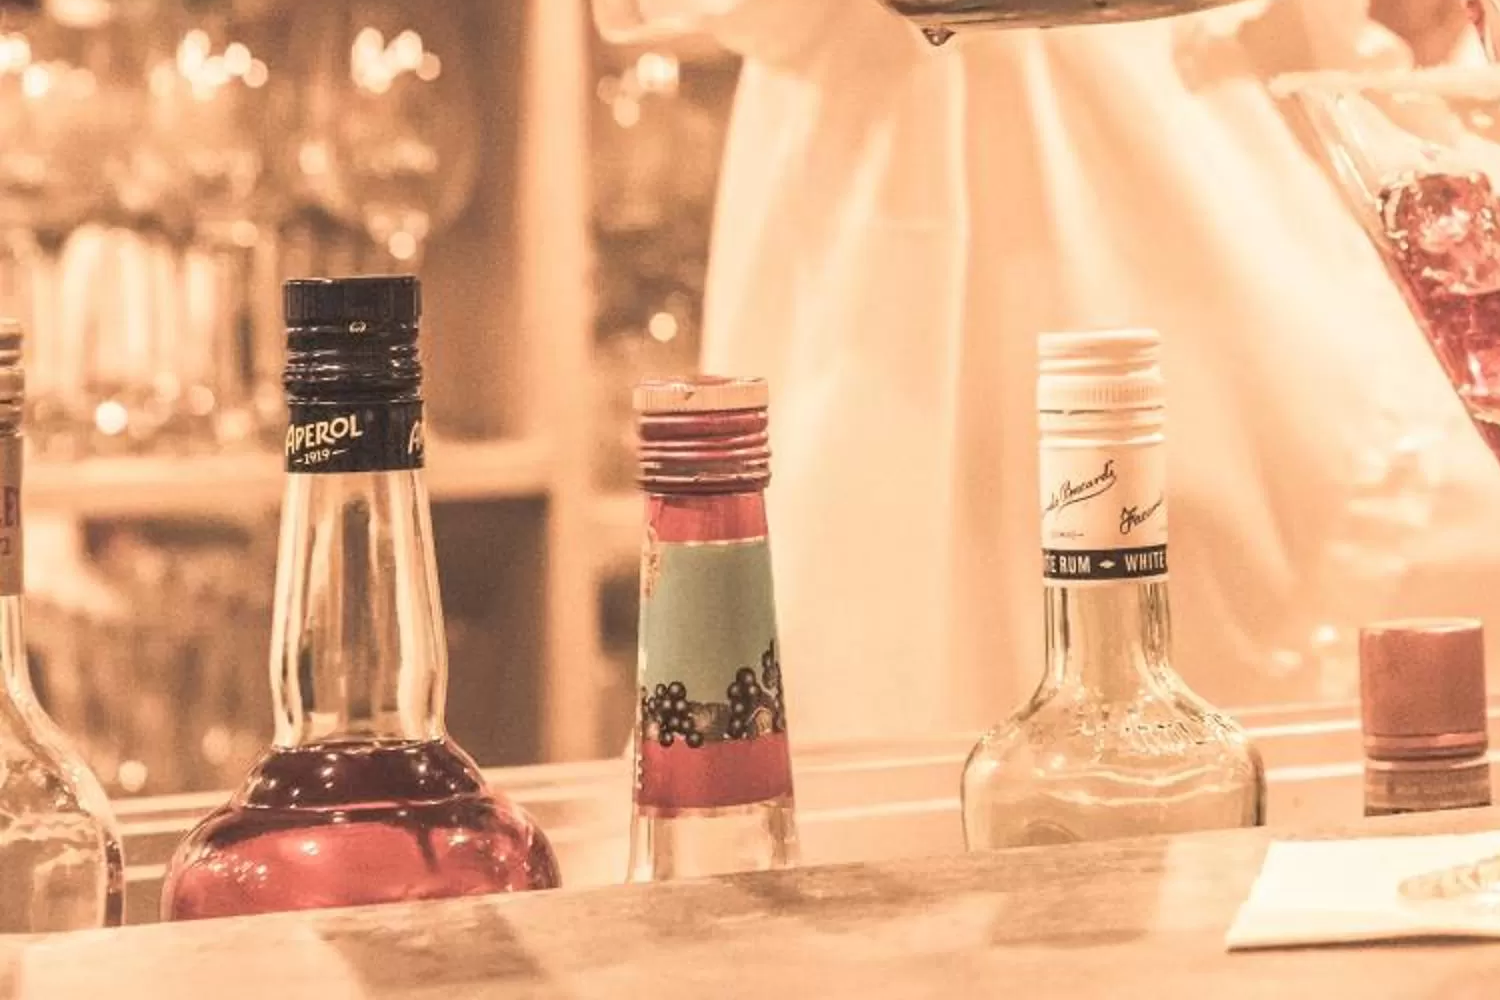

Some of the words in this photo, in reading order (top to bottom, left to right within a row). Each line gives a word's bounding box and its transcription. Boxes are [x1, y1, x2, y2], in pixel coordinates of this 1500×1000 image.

[285, 413, 365, 457] APEROL
[1058, 554, 1091, 574] RUM
[1124, 551, 1165, 573] WHITE
